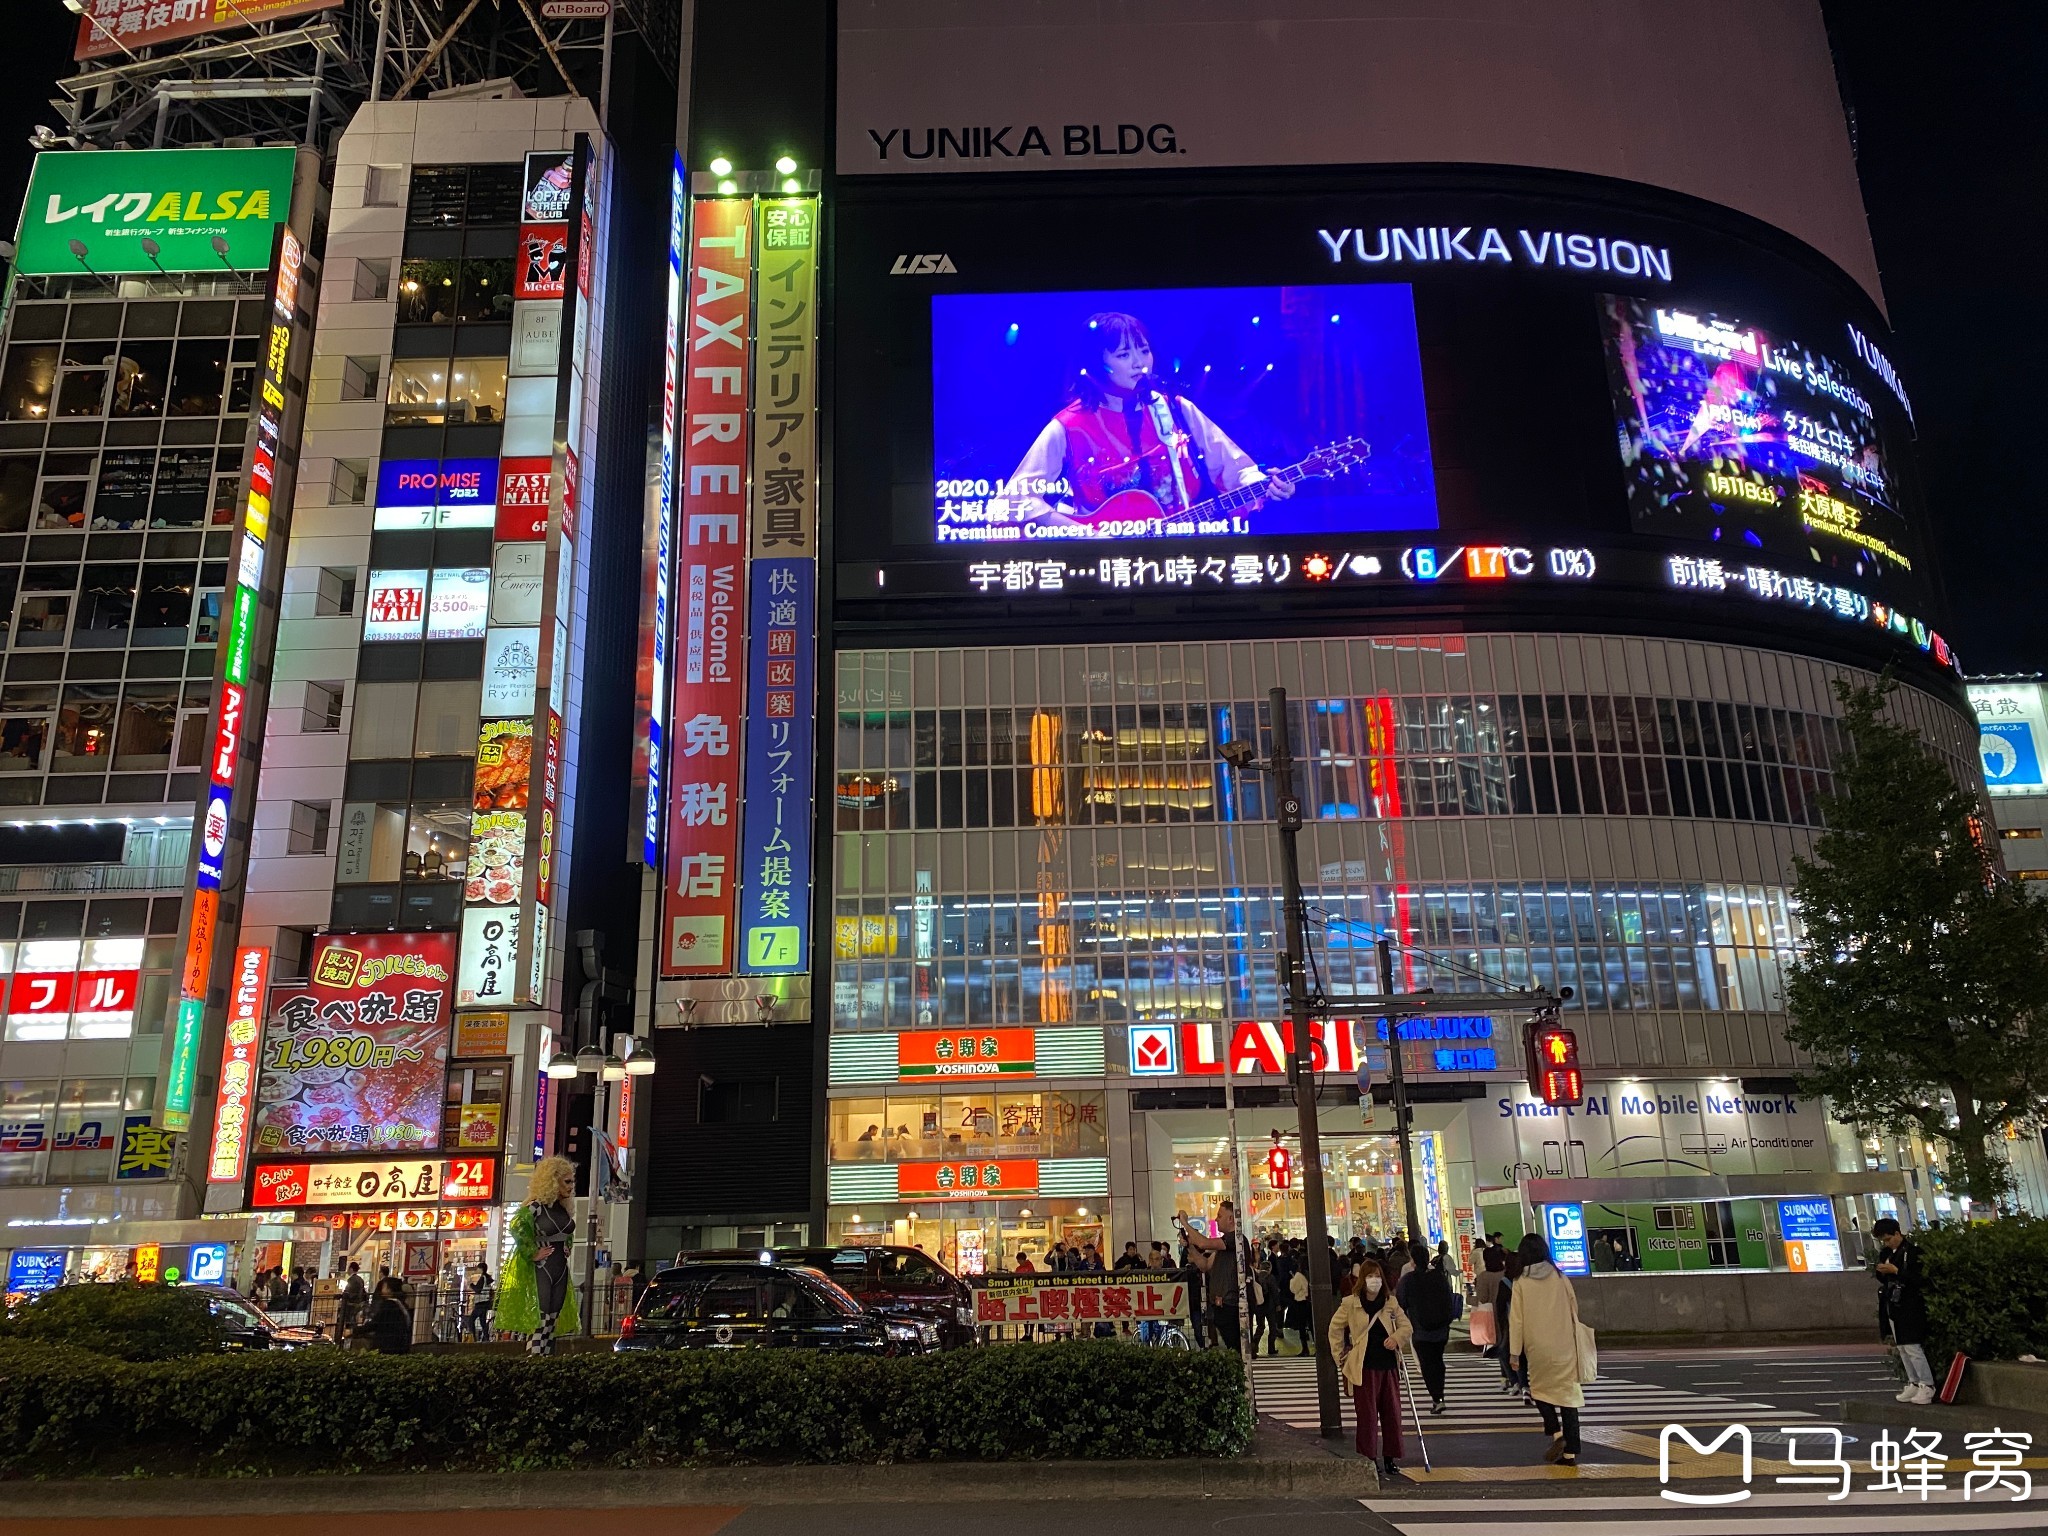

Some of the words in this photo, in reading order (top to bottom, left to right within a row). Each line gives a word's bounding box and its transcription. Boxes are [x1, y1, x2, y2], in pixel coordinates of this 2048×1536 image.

[867, 125, 1052, 161] YUNIKA
[1063, 123, 1187, 156] BLDG.
[45, 190, 270, 224] レイクALSA
[530, 201, 570, 211] STREET
[536, 210, 564, 219] CLUB
[766, 209, 811, 227] 安心
[766, 228, 811, 247] 保証
[889, 253, 958, 274] LISA
[1317, 226, 1513, 263] YUNIKA
[1518, 229, 1674, 282] VISION
[535, 316, 547, 324] 8F
[1762, 344, 1803, 381] Live
[1807, 362, 1874, 420] Selection
[761, 258, 807, 550] インテリア・家具
[1784, 410, 1856, 457] タカヒロキ
[399, 473, 481, 489] PROMISE
[506, 474, 551, 487] FAST
[1708, 472, 1776, 505] 1月11日(土)
[450, 488, 479, 498] プロミス
[505, 492, 550, 504] NAIL
[421, 511, 451, 525] 7F
[531, 519, 549, 532] 6F
[937, 523, 1020, 541] Premium
[1024, 520, 1094, 539] Concert
[1166, 520, 1195, 535] am
[1199, 518, 1230, 535] not
[1803, 513, 1840, 536] Premium
[1840, 525, 1868, 547] Concert
[516, 554, 531, 564] 5F
[371, 571, 383, 579] 6F
[500, 572, 542, 597] Emerge
[373, 588, 423, 602] FAST
[371, 608, 421, 622] NAIL
[709, 564, 735, 684] Welcome!
[428, 629, 465, 639] 当日予約
[466, 627, 486, 638] OK
[216, 686, 242, 778] アイフル
[482, 746, 500, 755] 炭火
[677, 713, 730, 898] 免税店
[207, 812, 226, 846] 薬
[345, 828, 359, 875] Rydia
[759, 931, 789, 962] 7F
[326, 952, 354, 970] 炭火
[358, 953, 448, 987] カルビちゃん
[476, 920, 504, 999] 日高屋
[320, 967, 351, 985] 焼肉
[279, 989, 443, 1034] 食べ放題
[1377, 1017, 1494, 1041] SHINJUKU
[1181, 1020, 1359, 1075] LABI
[1434, 1048, 1497, 1072] 東口館
[536, 1077, 546, 1142] PROMISE
[960, 1106, 988, 1127] 2F
[1003, 1104, 1044, 1126] 客席
[1056, 1103, 1099, 1125] 19席
[1499, 1097, 1575, 1118] Smart
[1586, 1096, 1610, 1116] AI
[1621, 1094, 1699, 1116] Mobile
[1706, 1094, 1798, 1116] Network
[286, 1123, 371, 1147] 食べ放題
[470, 1131, 491, 1140] FREE
[472, 1123, 488, 1131] TAX
[119, 1122, 173, 1171] 薬
[1731, 1137, 1747, 1149] Air
[1750, 1137, 1815, 1150] Conditioner
[260, 1167, 294, 1187] ちょい
[313, 1174, 352, 1190] 中華食堂
[356, 1164, 440, 1200] 日高屋
[454, 1162, 485, 1184] 24
[276, 1181, 304, 1203] 飲み
[1784, 1203, 1829, 1217] SUBNADE
[1553, 1213, 1568, 1236] P
[1649, 1236, 1703, 1251] Kitchen
[194, 1252, 212, 1277] P
[1792, 1246, 1802, 1267] 6
[1038, 1278, 1050, 1286] on
[1052, 1276, 1069, 1285] the
[1072, 1275, 1102, 1285] street
[1104, 1275, 1114, 1284] is
